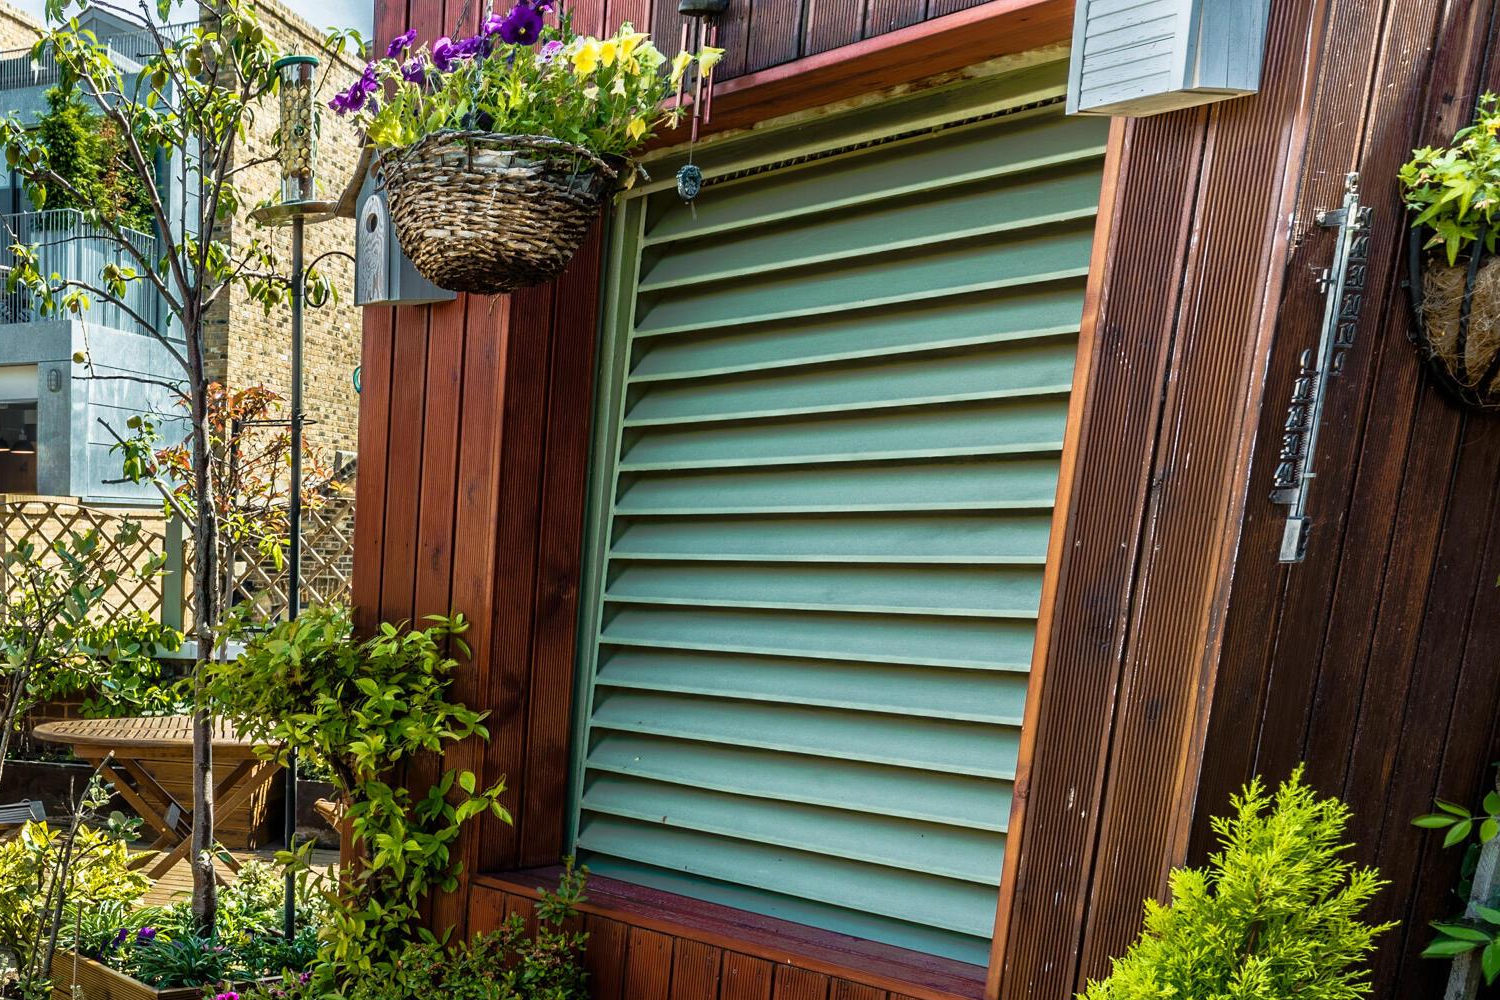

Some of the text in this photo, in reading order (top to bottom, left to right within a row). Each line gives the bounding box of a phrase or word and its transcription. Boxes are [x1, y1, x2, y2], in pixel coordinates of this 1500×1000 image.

[1350, 236, 1370, 257] 40
[1346, 265, 1365, 287] 30
[1341, 293, 1361, 315] 20
[1338, 322, 1356, 343] 10
[1292, 377, 1310, 399] 10
[1285, 405, 1304, 428] 20
[1280, 433, 1299, 455] 30
[1273, 461, 1293, 483] 40
